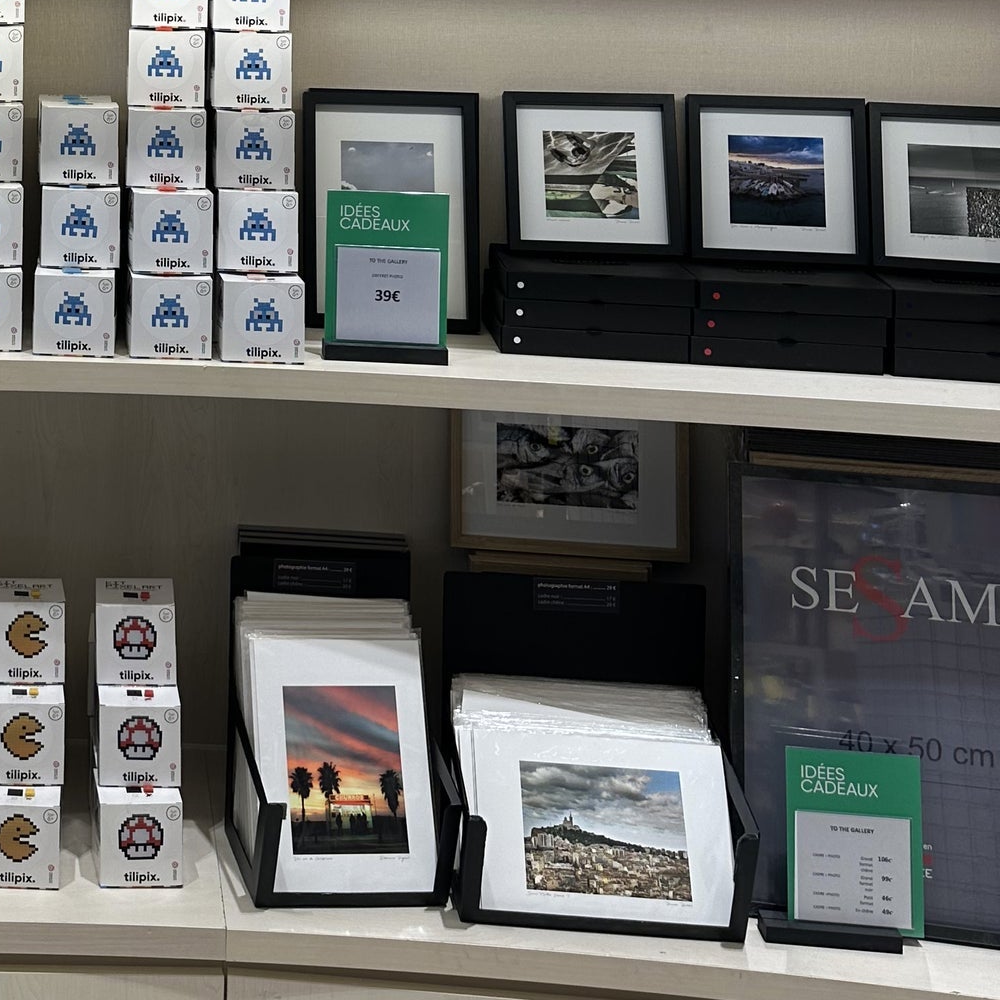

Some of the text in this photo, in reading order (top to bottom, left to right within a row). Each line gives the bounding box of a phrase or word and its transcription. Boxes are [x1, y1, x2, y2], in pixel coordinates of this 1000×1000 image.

[154, 13, 186, 24] tilipix.
[235, 16, 267, 27] tilipix.
[149, 92, 183, 104] tilipix.
[237, 94, 270, 105] tilipix.
[63, 170, 96, 181] tilipix.
[150, 173, 183, 185] tilipix.
[239, 175, 272, 186] tilipix.
[340, 202, 380, 218] IDÉES
[340, 217, 410, 231] CADEAUX
[63, 253, 97, 264] tilipix.
[156, 258, 190, 269] tilipix.
[241, 256, 275, 268] tilipix.
[375, 289, 401, 302] 39€
[57, 340, 91, 352] tilipix.
[154, 343, 188, 355] tilipix.
[246, 347, 281, 359] tilipix.
[8, 668, 42, 680] tilipix.
[120, 670, 153, 682] tilipix.
[839, 729, 994, 768] 40 x 50 cm
[6, 770, 40, 781] tilipix.
[123, 772, 157, 784] tilipix.
[801, 763, 845, 781] IDÉES
[801, 779, 878, 798] CADEAUX
[0, 872, 35, 884] tilipix.
[124, 872, 159, 884] tilipix.
